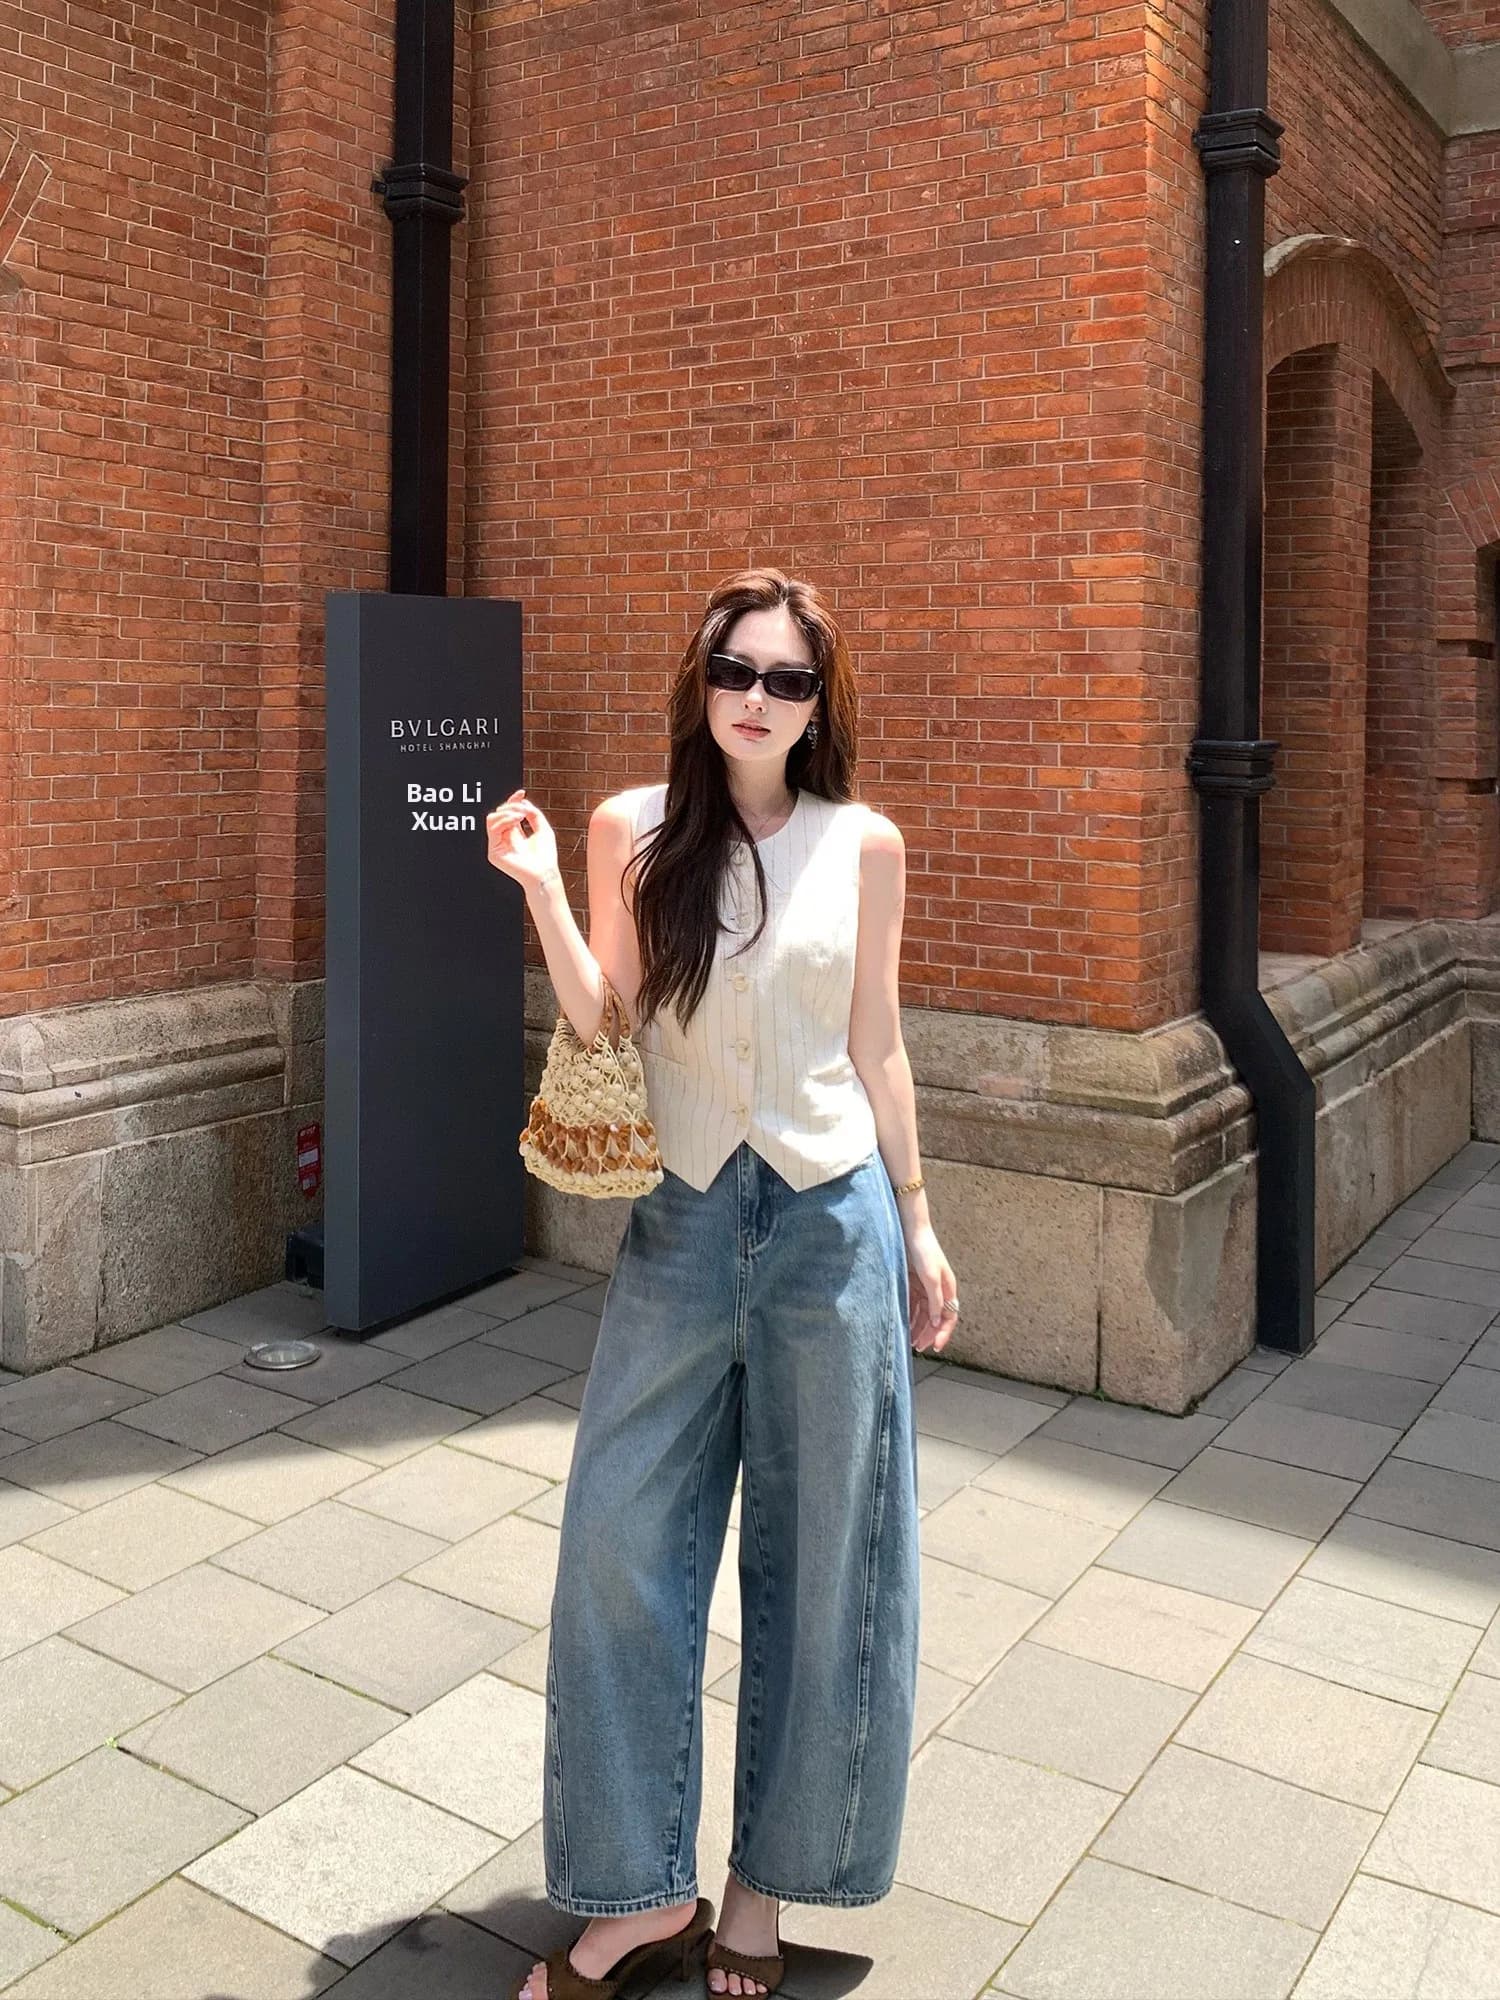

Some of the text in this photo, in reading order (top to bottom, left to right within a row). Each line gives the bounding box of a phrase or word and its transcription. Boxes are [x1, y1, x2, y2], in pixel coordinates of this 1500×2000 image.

[390, 717, 498, 738] BVLGARI
[400, 741, 491, 753] HOTEL SHANGHAI
